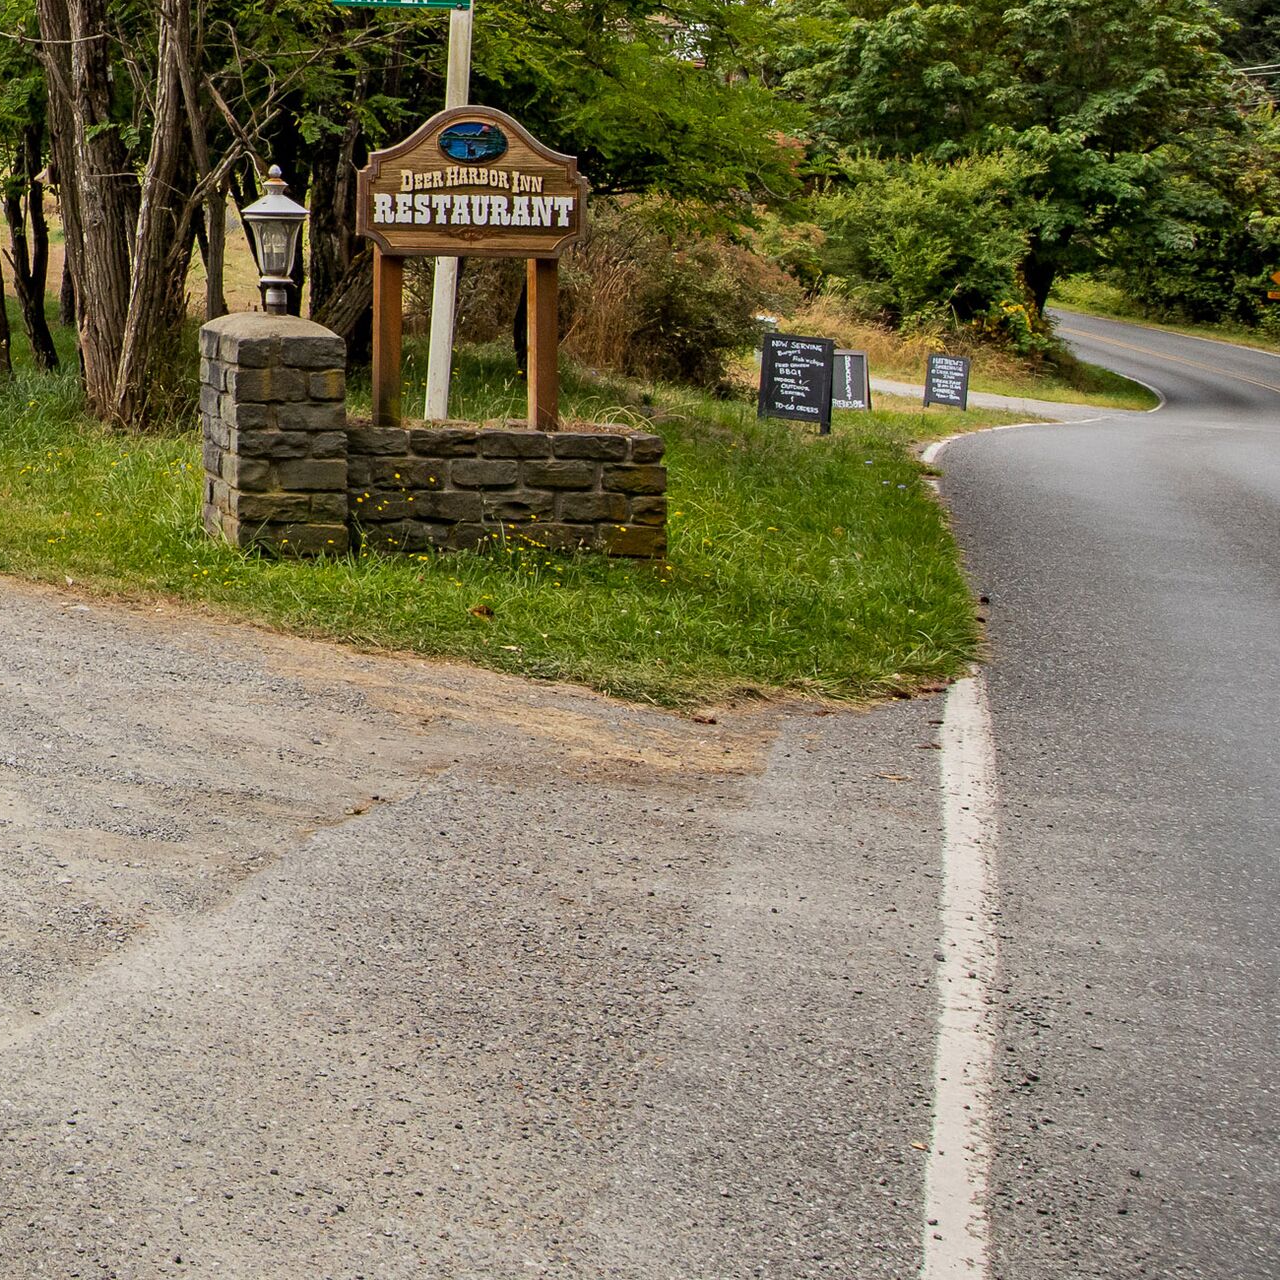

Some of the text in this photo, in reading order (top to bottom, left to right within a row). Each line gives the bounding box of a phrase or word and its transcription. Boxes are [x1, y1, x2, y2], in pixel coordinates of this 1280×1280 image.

[400, 165, 543, 193] DEER HARBOR INN
[373, 192, 574, 227] RESTAURANT
[771, 340, 823, 352] NOW SERVING
[796, 405, 819, 413] ORDERS
